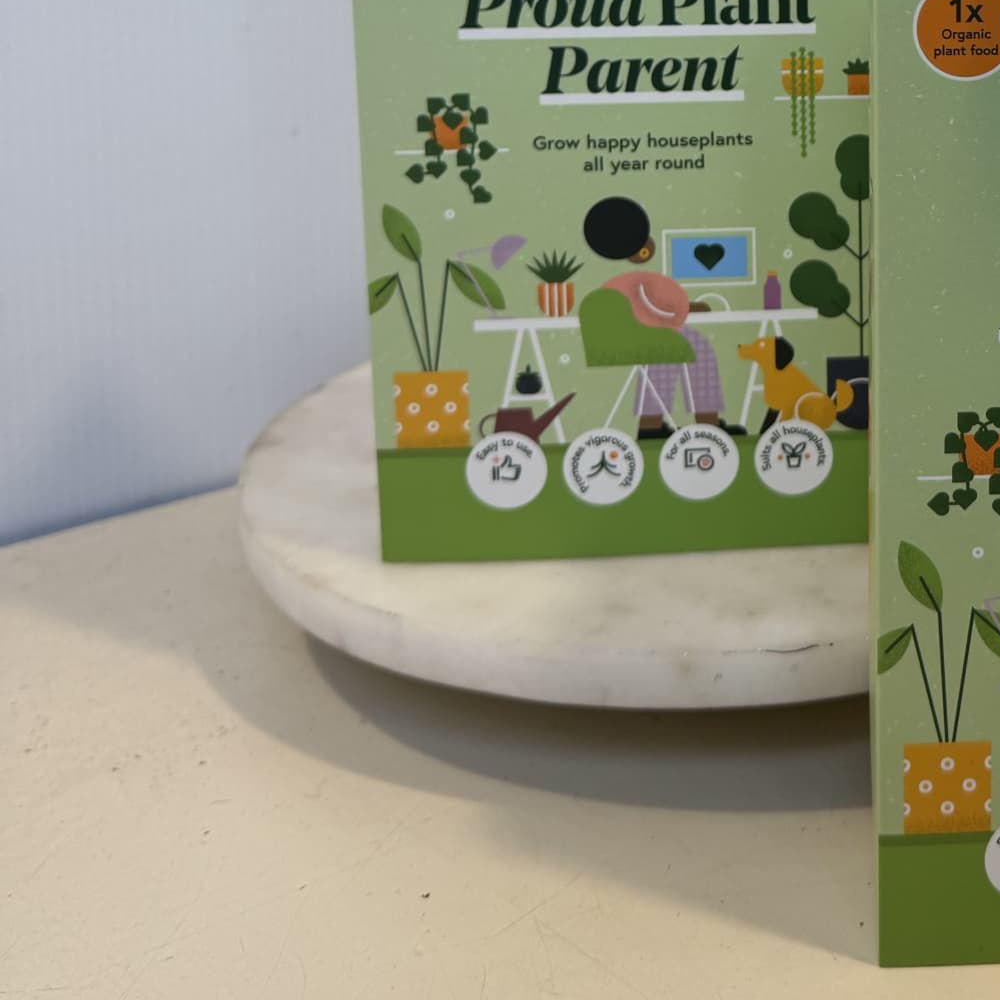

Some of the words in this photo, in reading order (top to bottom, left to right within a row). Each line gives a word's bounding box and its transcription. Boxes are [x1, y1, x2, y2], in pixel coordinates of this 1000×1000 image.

[941, 28, 991, 42] Organic
[933, 44, 966, 59] plant
[971, 44, 999, 56] food
[540, 44, 744, 95] Parent
[532, 135, 580, 151] Grow
[586, 133, 641, 153] happy
[647, 131, 753, 150] houseplants
[583, 155, 604, 172] all
[610, 158, 649, 175] year
[655, 153, 705, 171] round
[476, 440, 499, 460] Easy
[501, 438, 514, 447] to
[584, 434, 629, 452] vigorous
[665, 444, 679, 460] For
[679, 431, 691, 445] all
[761, 444, 773, 472] Suits
[770, 430, 782, 444] all
